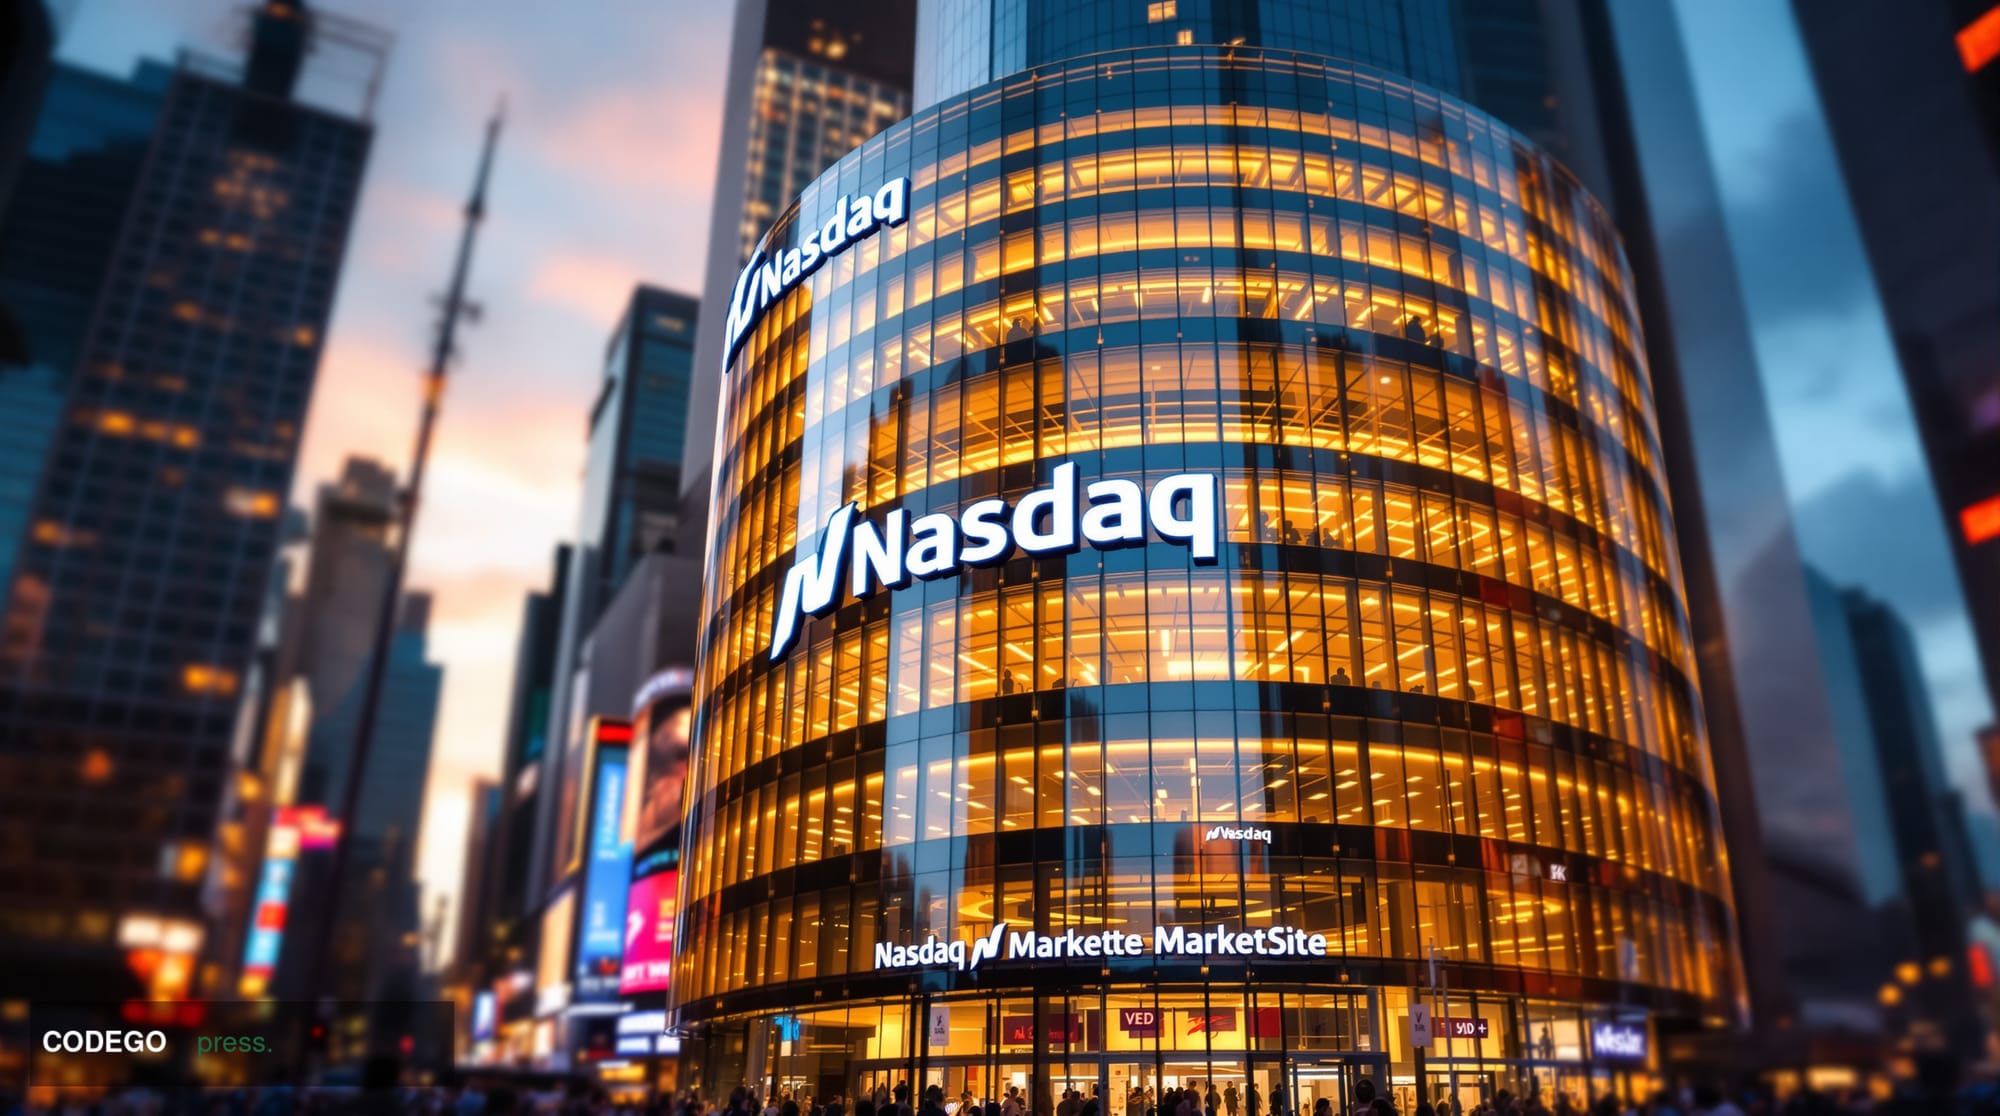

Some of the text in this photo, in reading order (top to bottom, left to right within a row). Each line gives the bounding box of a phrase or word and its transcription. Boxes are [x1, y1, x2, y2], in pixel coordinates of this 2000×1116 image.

[762, 177, 909, 309] Nasdaq
[852, 462, 1216, 597] Nasdaq
[875, 924, 1328, 970] Nasdaq Markette MarketSite
[1125, 1012, 1154, 1025] VED
